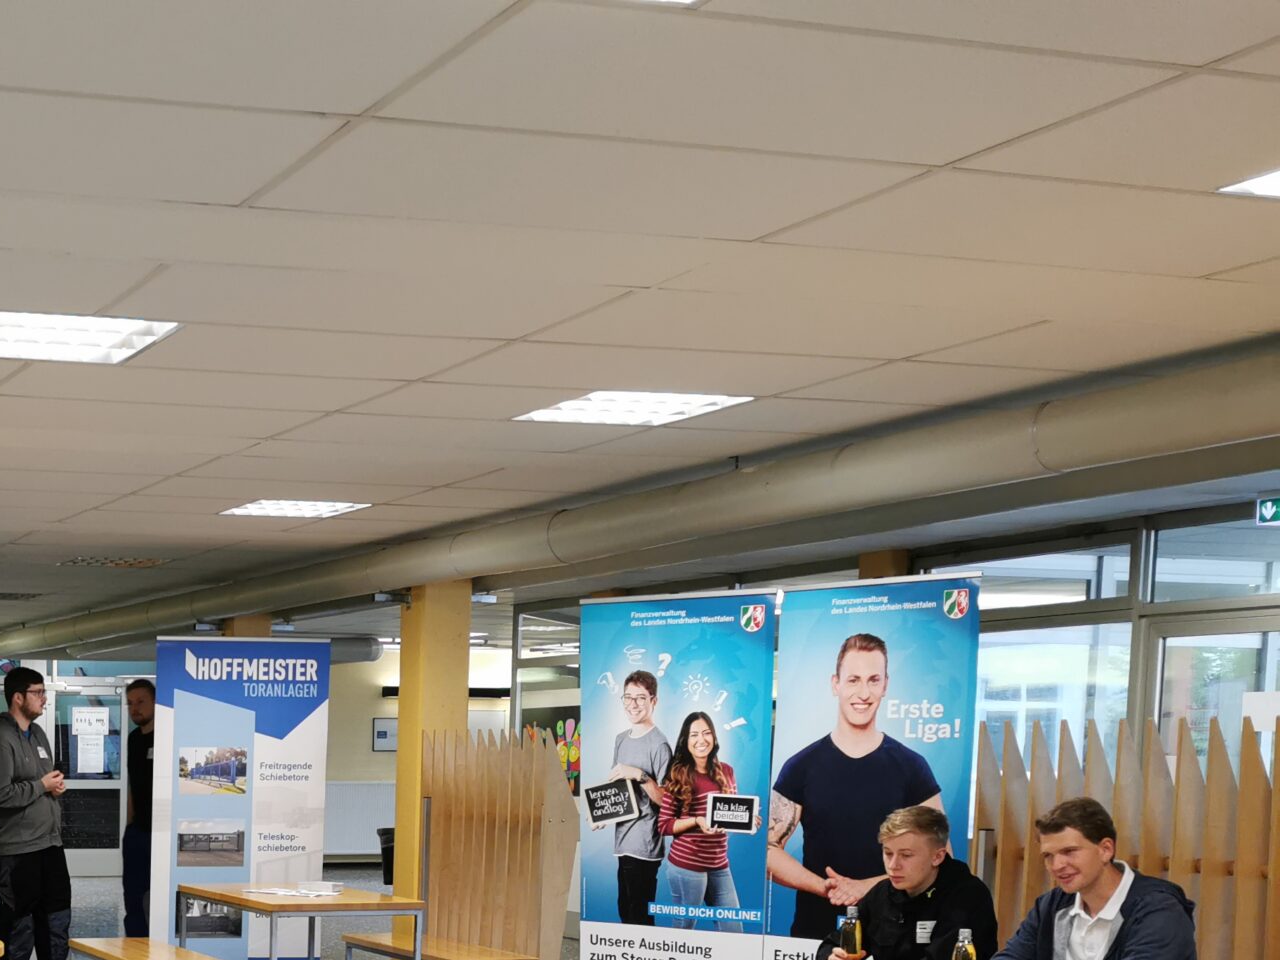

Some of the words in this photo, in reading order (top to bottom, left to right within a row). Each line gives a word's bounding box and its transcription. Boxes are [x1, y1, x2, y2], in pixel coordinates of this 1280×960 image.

[831, 595, 889, 605] Finanzverwaltung
[630, 609, 687, 618] Finanzverwaltung
[831, 607, 843, 615] des
[844, 605, 868, 614] Landes
[868, 601, 937, 612] Nordrhein-Westfalen
[630, 619, 643, 627] des
[667, 615, 735, 625] Nordrhein-Westfalen
[197, 657, 318, 682] HOFFMEISTER
[242, 682, 318, 698] TORANLAGEN
[887, 699, 945, 719] Erste
[904, 718, 961, 743] Liga!
[259, 761, 313, 772] Freitragende
[259, 773, 310, 781] Schiebetore
[588, 787, 619, 800] lernen
[594, 791, 629, 808] digital?
[593, 801, 628, 816] analog?
[716, 802, 729, 811] Na
[715, 811, 747, 821] beides!
[257, 833, 299, 842] Teleskop-
[257, 844, 307, 852] schiebetore
[649, 904, 686, 916] BEWIRB
[688, 907, 713, 918] DICH
[716, 909, 761, 921] ONLINE!
[589, 933, 636, 949] Unsere
[638, 937, 712, 959] Ausbildung
